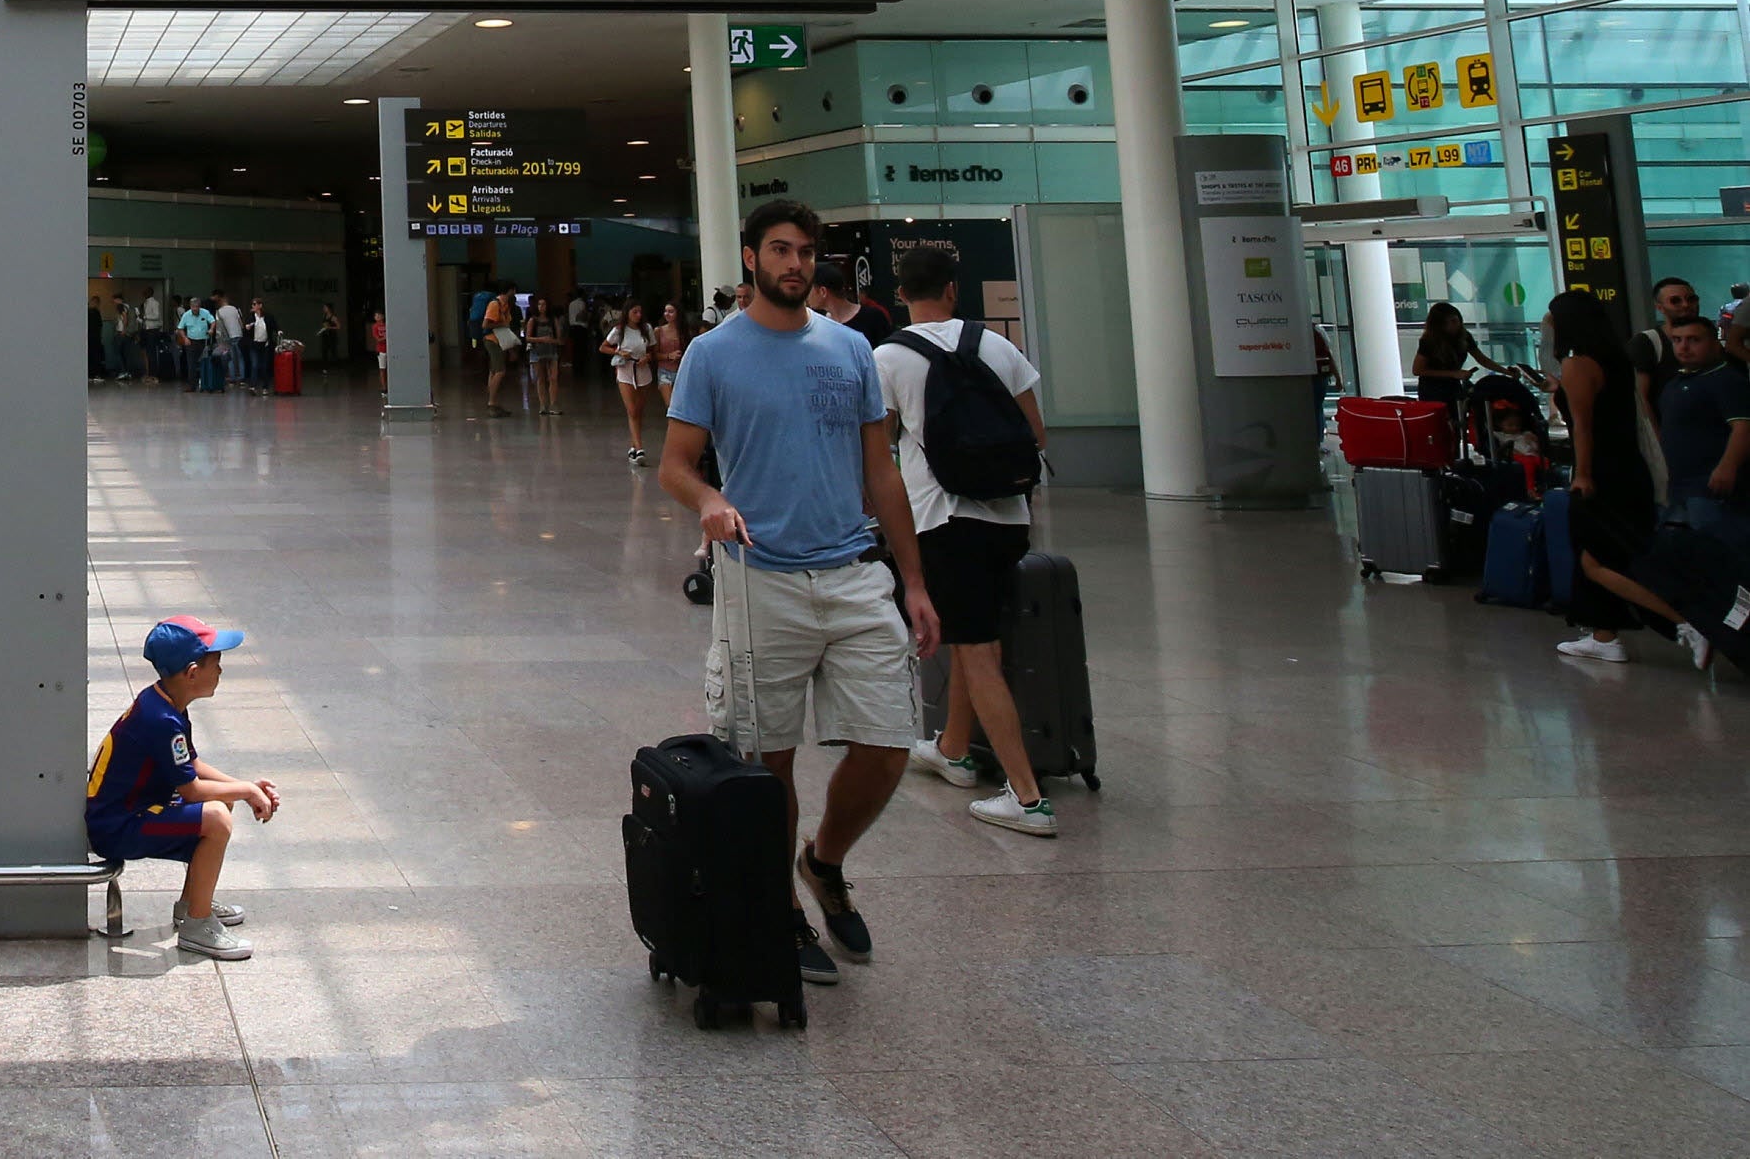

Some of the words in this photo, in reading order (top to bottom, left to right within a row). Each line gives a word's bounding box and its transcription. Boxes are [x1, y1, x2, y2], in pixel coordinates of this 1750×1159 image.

[72, 82, 86, 129] 00703
[468, 111, 505, 119] Sortides
[469, 129, 502, 138] Salidas
[72, 137, 84, 155] SE
[470, 148, 513, 157] Facturació
[1410, 151, 1431, 166] L77
[1437, 148, 1459, 163] L99
[471, 166, 519, 175] Facturación
[522, 162, 547, 175] 201
[556, 162, 581, 175] 799
[1334, 159, 1348, 172] 46
[1357, 157, 1377, 171] PR1
[909, 165, 960, 182] items
[471, 186, 514, 194] Arribades
[472, 205, 511, 214] Llegadas
[494, 224, 507, 234] La
[510, 224, 539, 237] Plaça
[890, 238, 917, 249] Your
[1567, 261, 1585, 271] Bus
[1595, 288, 1617, 301] VIP
[806, 365, 843, 378] INDIGO
